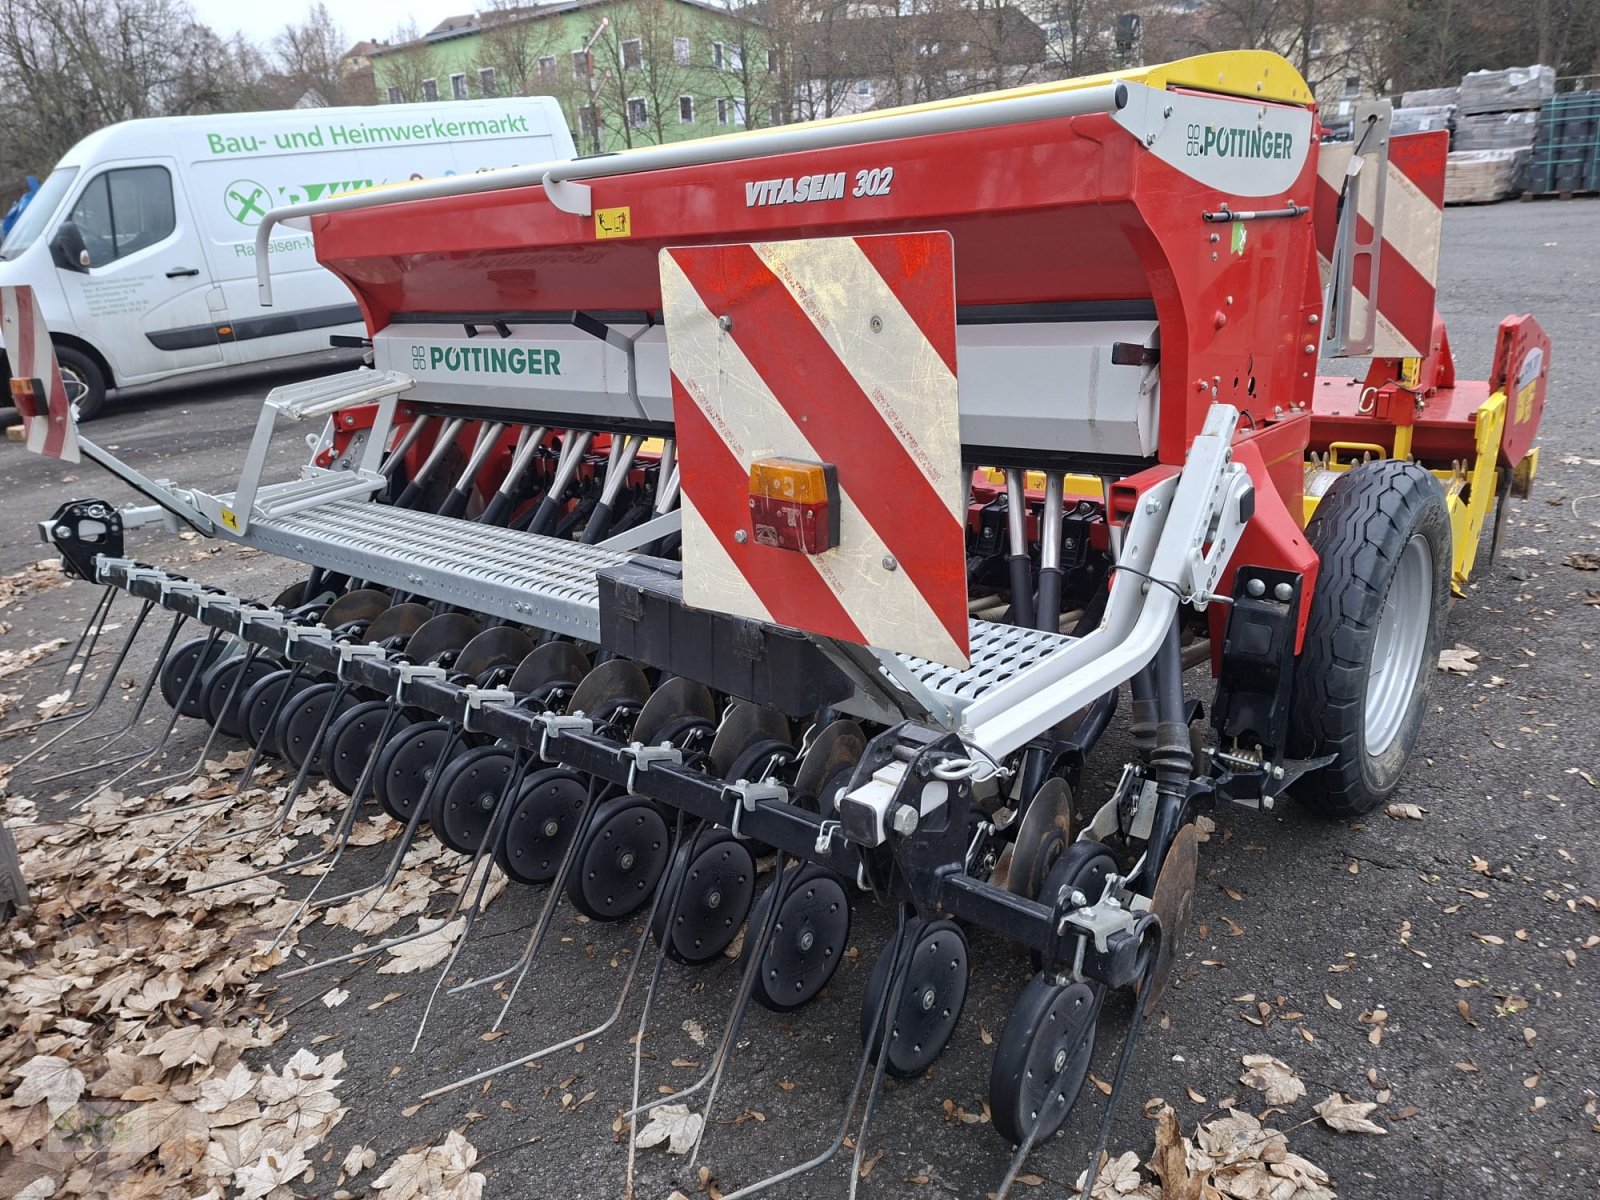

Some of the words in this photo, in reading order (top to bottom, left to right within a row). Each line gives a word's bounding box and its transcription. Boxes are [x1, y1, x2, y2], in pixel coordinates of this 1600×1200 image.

[207, 133, 267, 154] Bau-
[274, 125, 324, 149] und
[329, 113, 529, 145] Heimwerkermarkt
[1204, 126, 1293, 159] PÖTTINGER
[745, 172, 846, 207] VITASEM
[852, 166, 894, 198] 302
[429, 346, 561, 375] PÖTTINGER
